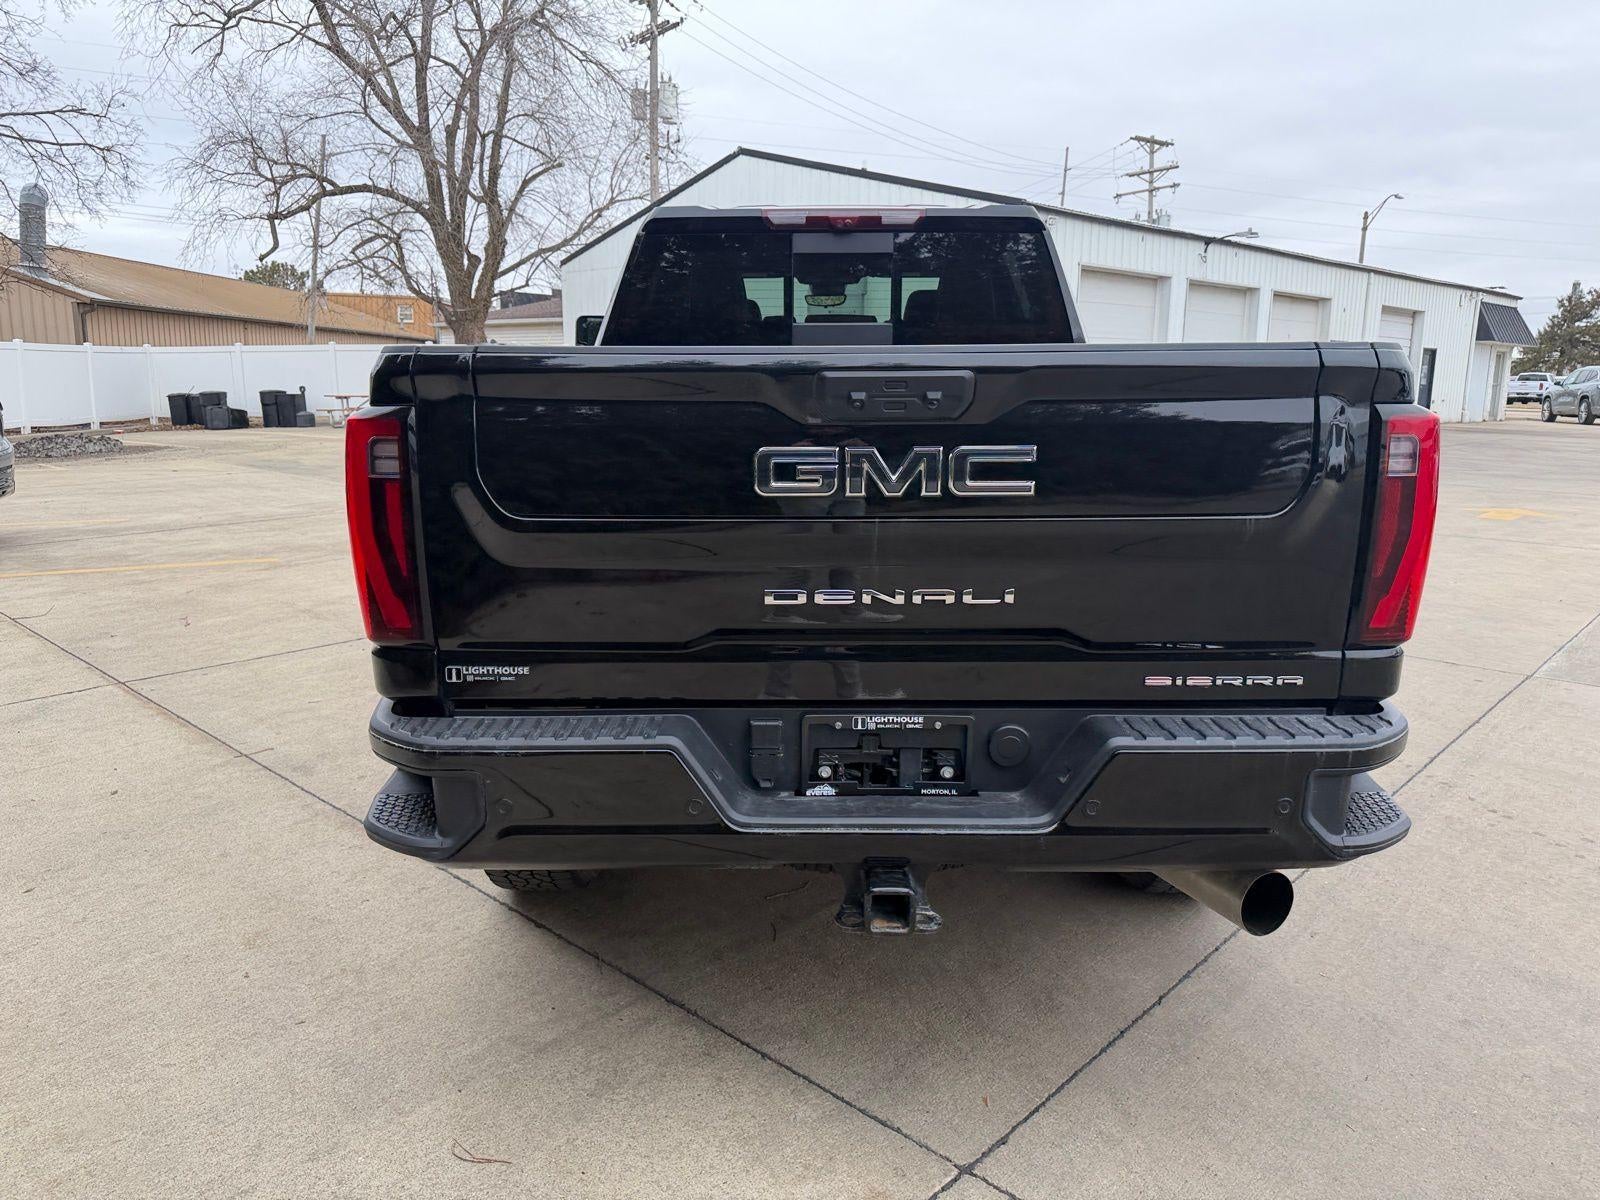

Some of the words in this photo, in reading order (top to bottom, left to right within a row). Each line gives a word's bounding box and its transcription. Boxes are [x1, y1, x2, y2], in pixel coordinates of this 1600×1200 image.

[754, 445, 1037, 496] GMC
[764, 588, 1015, 605] DENALI
[462, 666, 530, 675] LIGHTHOUSE
[1144, 675, 1304, 686] SIERRA
[805, 788, 837, 796] everest
[920, 788, 950, 796] MORTON,
